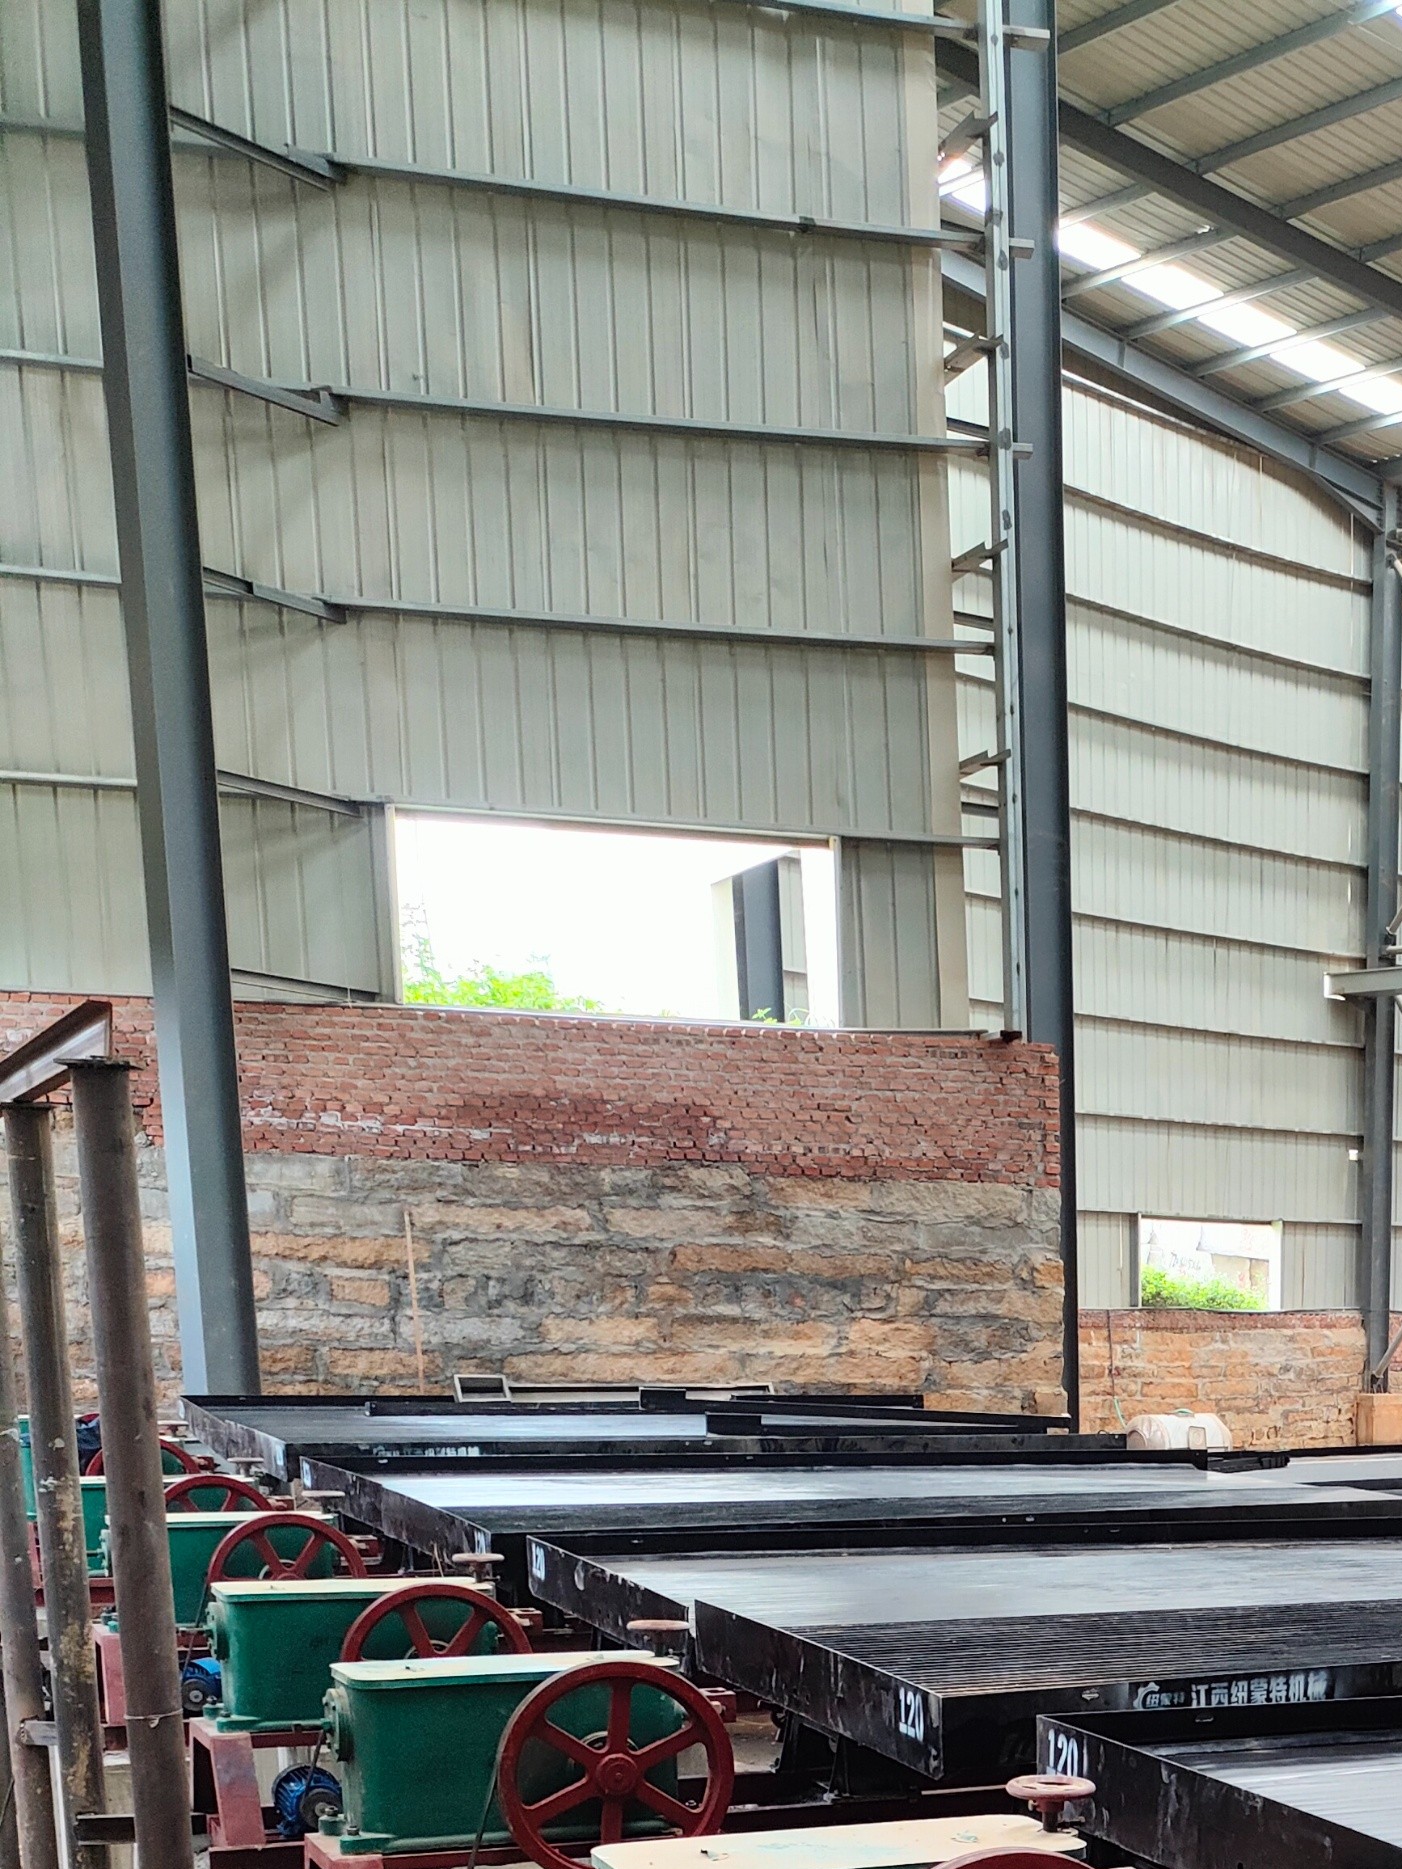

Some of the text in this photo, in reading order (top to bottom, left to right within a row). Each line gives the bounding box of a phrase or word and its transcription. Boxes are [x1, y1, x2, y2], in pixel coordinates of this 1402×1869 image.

[1191, 1670, 1328, 1707] 江西纽蒙特机械
[899, 1687, 925, 1742] 120
[1046, 1728, 1078, 1776] 120
